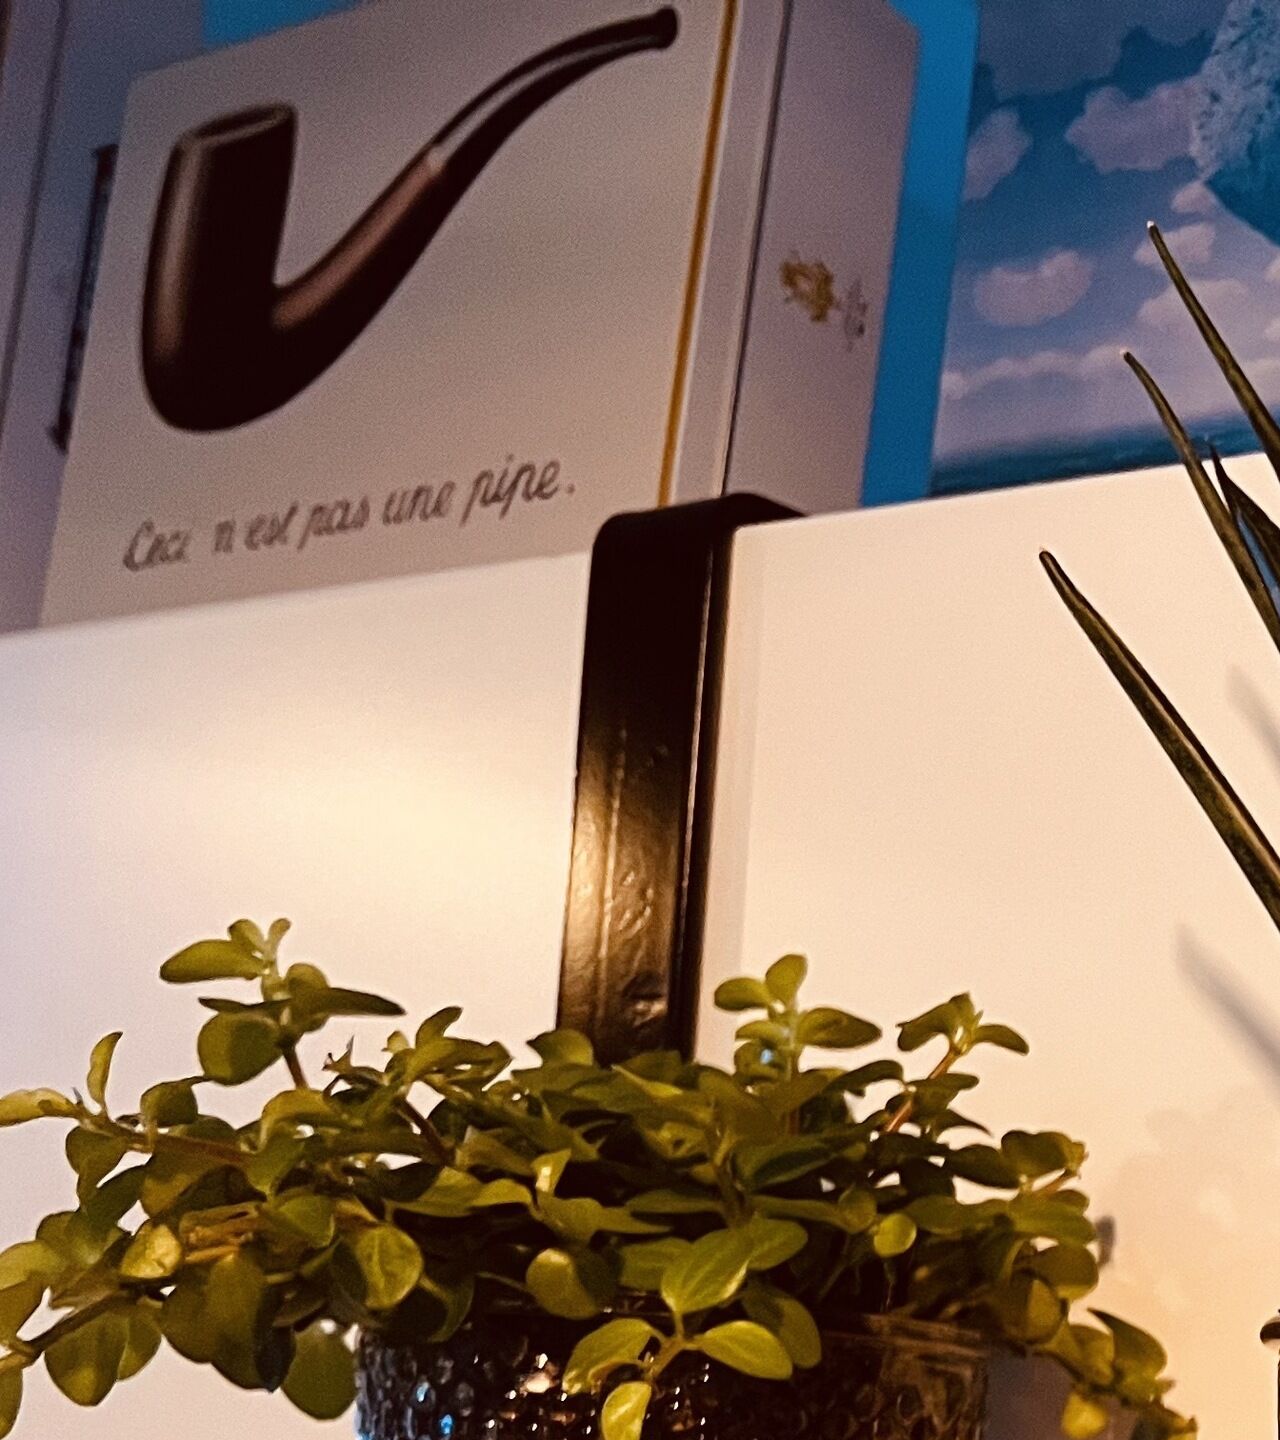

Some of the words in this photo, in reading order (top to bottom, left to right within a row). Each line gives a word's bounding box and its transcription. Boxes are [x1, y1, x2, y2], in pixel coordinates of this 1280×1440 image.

[122, 520, 191, 572] Ceci
[297, 496, 371, 552] pas
[382, 480, 456, 526] une
